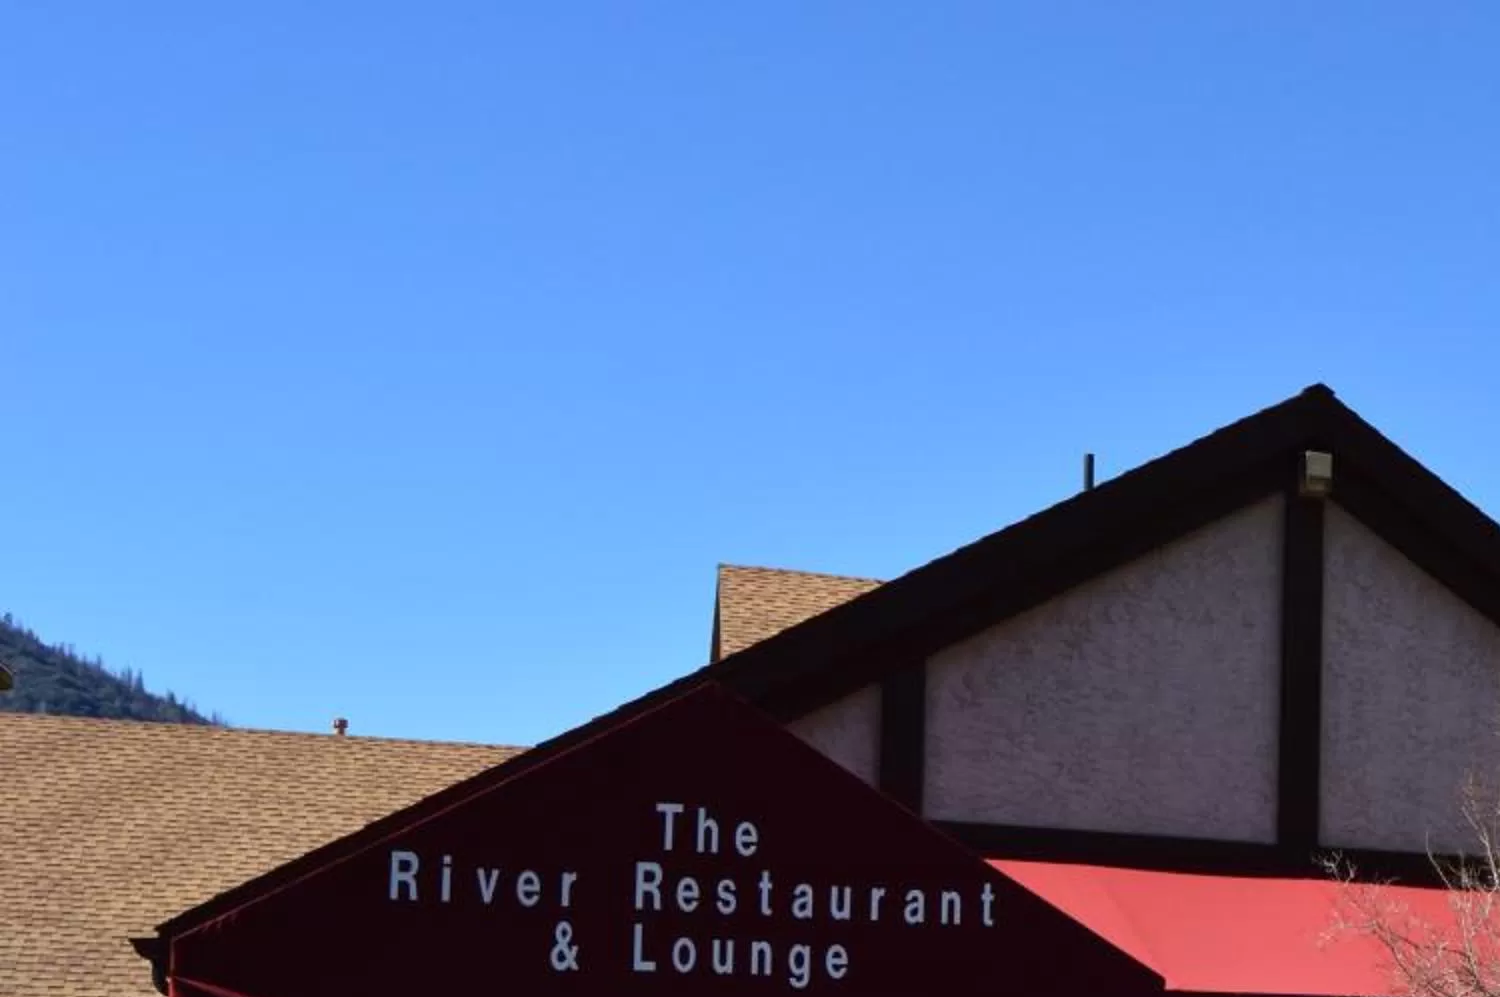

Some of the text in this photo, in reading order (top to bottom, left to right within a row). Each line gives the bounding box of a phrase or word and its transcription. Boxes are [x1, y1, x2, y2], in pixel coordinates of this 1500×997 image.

[655, 803, 759, 857] The
[390, 851, 997, 927] River Restaurant
[549, 921, 850, 988] & Lounge
